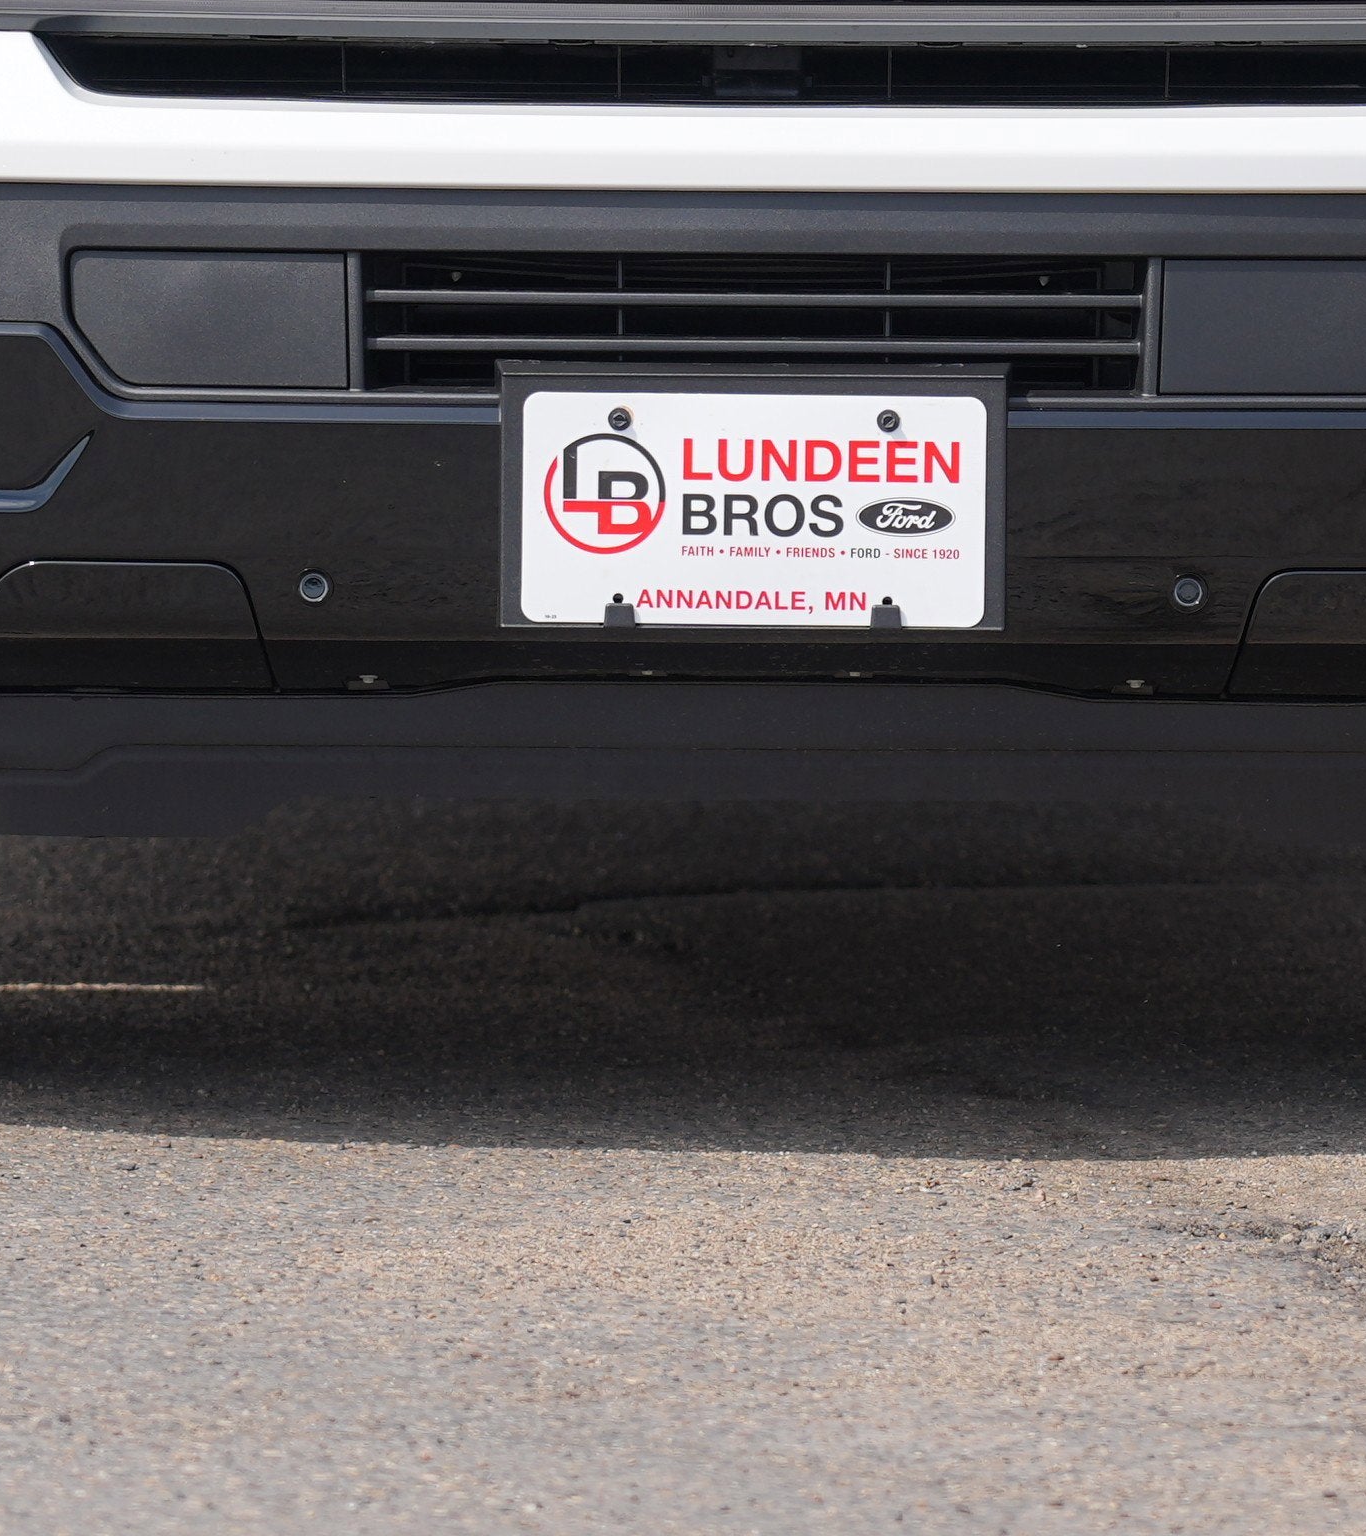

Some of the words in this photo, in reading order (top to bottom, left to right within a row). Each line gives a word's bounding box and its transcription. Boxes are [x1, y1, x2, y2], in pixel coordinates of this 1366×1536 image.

[682, 437, 961, 484] LUNDEEN
[681, 493, 844, 538] BROS
[875, 502, 937, 529] Ford
[681, 545, 715, 557] FAITH
[729, 546, 772, 558] FAMILY
[785, 547, 836, 559] FRIENDS
[850, 547, 881, 559] FORD
[893, 548, 928, 560] SINCE
[931, 548, 960, 560] 1920
[636, 588, 815, 615] ANNANDALE,
[824, 591, 867, 612] MN
